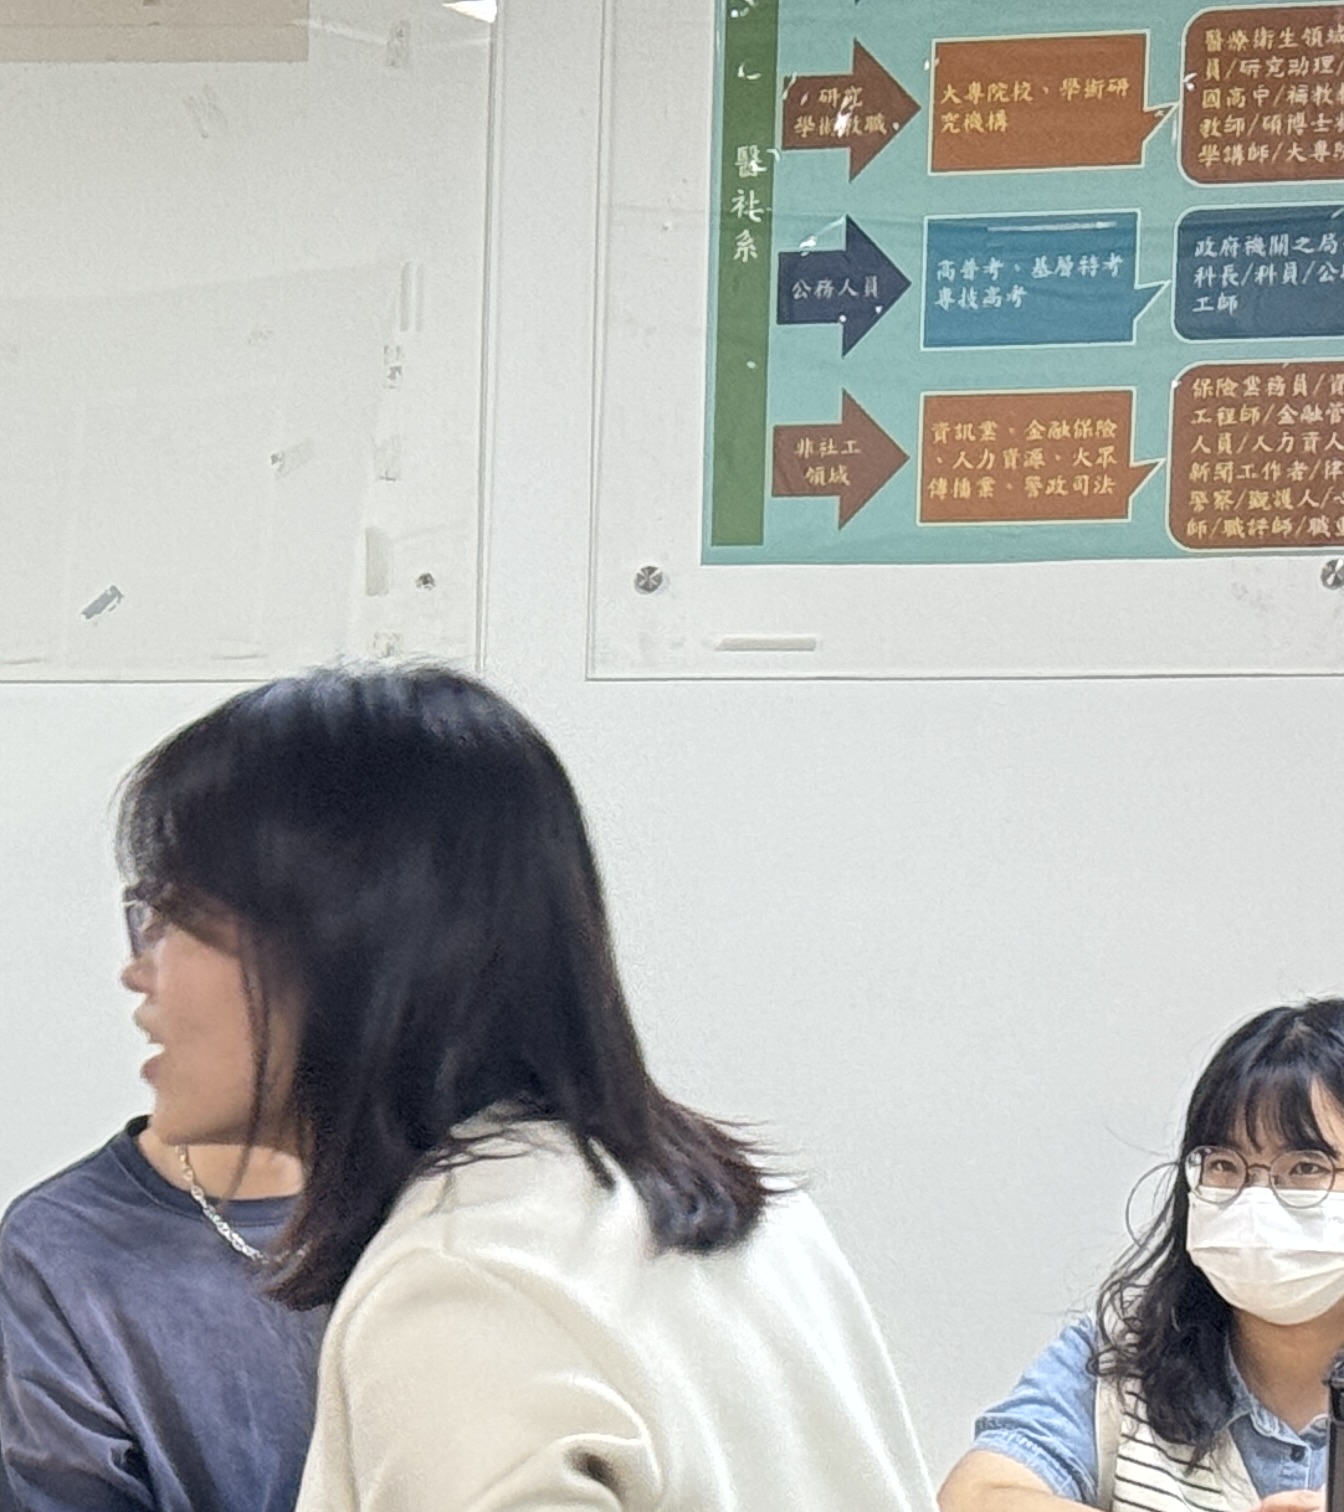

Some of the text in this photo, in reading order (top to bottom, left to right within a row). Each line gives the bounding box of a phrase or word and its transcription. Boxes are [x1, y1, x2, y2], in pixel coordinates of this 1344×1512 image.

[940, 77, 1130, 105] 大專院校、學術研
[940, 109, 1010, 134] 究機構
[1194, 232, 1344, 259] 政府機關之局
[1193, 259, 1344, 288] 科長/科員/公
[792, 275, 879, 300] 公務人員
[934, 284, 1028, 310] 專技高考
[1192, 292, 1239, 316] 工師
[793, 437, 862, 459] 非社工
[804, 464, 851, 487] 領域
